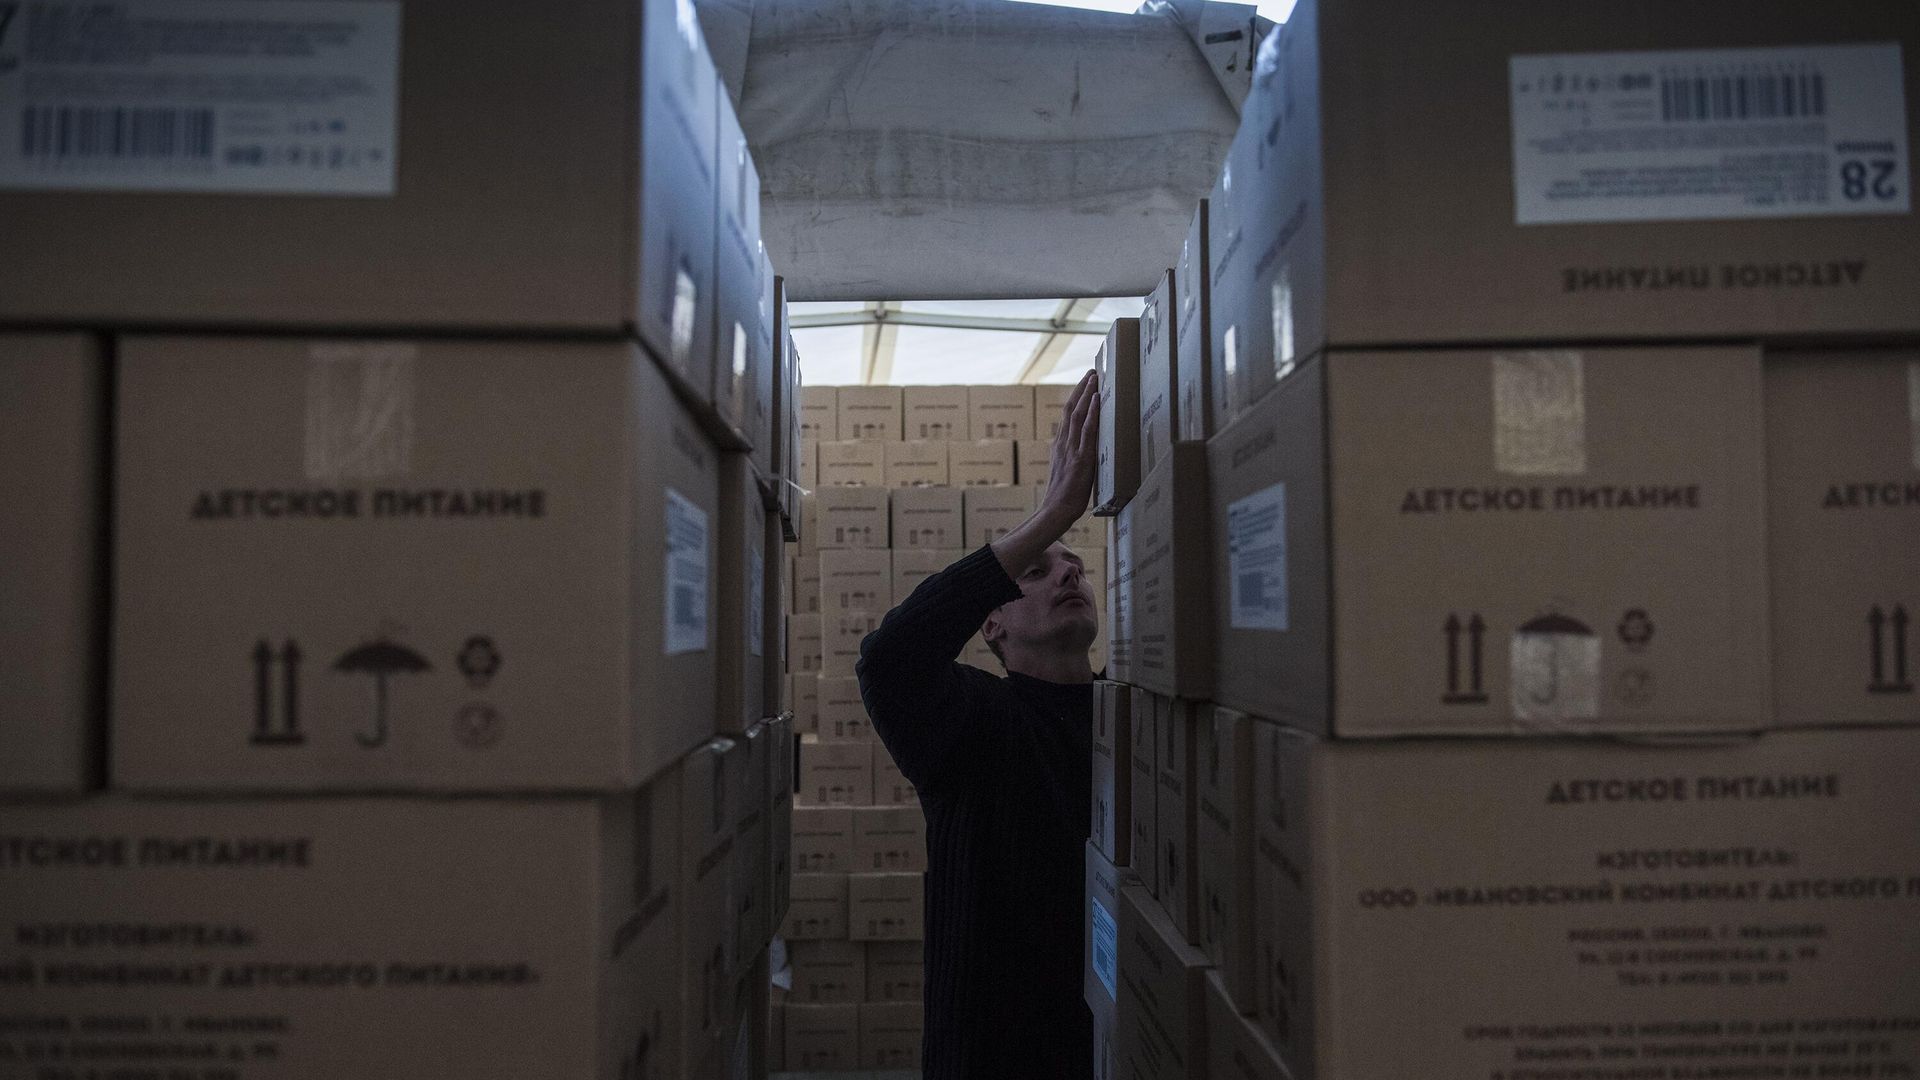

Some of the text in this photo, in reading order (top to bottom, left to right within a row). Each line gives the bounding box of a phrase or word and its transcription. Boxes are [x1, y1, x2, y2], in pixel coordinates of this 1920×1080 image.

[1841, 160, 1897, 201] 28
[1561, 257, 1867, 293] ДЕТСКОЕ ПИТАНИЕ
[188, 488, 547, 520] ДЕТСКОЕ ПИТАНИЕ
[1401, 484, 1700, 514] ДЕТСКОЕ ПИТАНИЕ
[1546, 773, 1841, 805] ДЕТСКОЕ ПИТАНИЕ
[138, 836, 314, 868] ПИТАНИЕ
[1359, 886, 1417, 909] ООО
[1621, 880, 1760, 903] КОМБИНАТ
[1767, 876, 1900, 902] ДЕТСКОГО
[218, 961, 378, 988] ДЕТСКОГО
